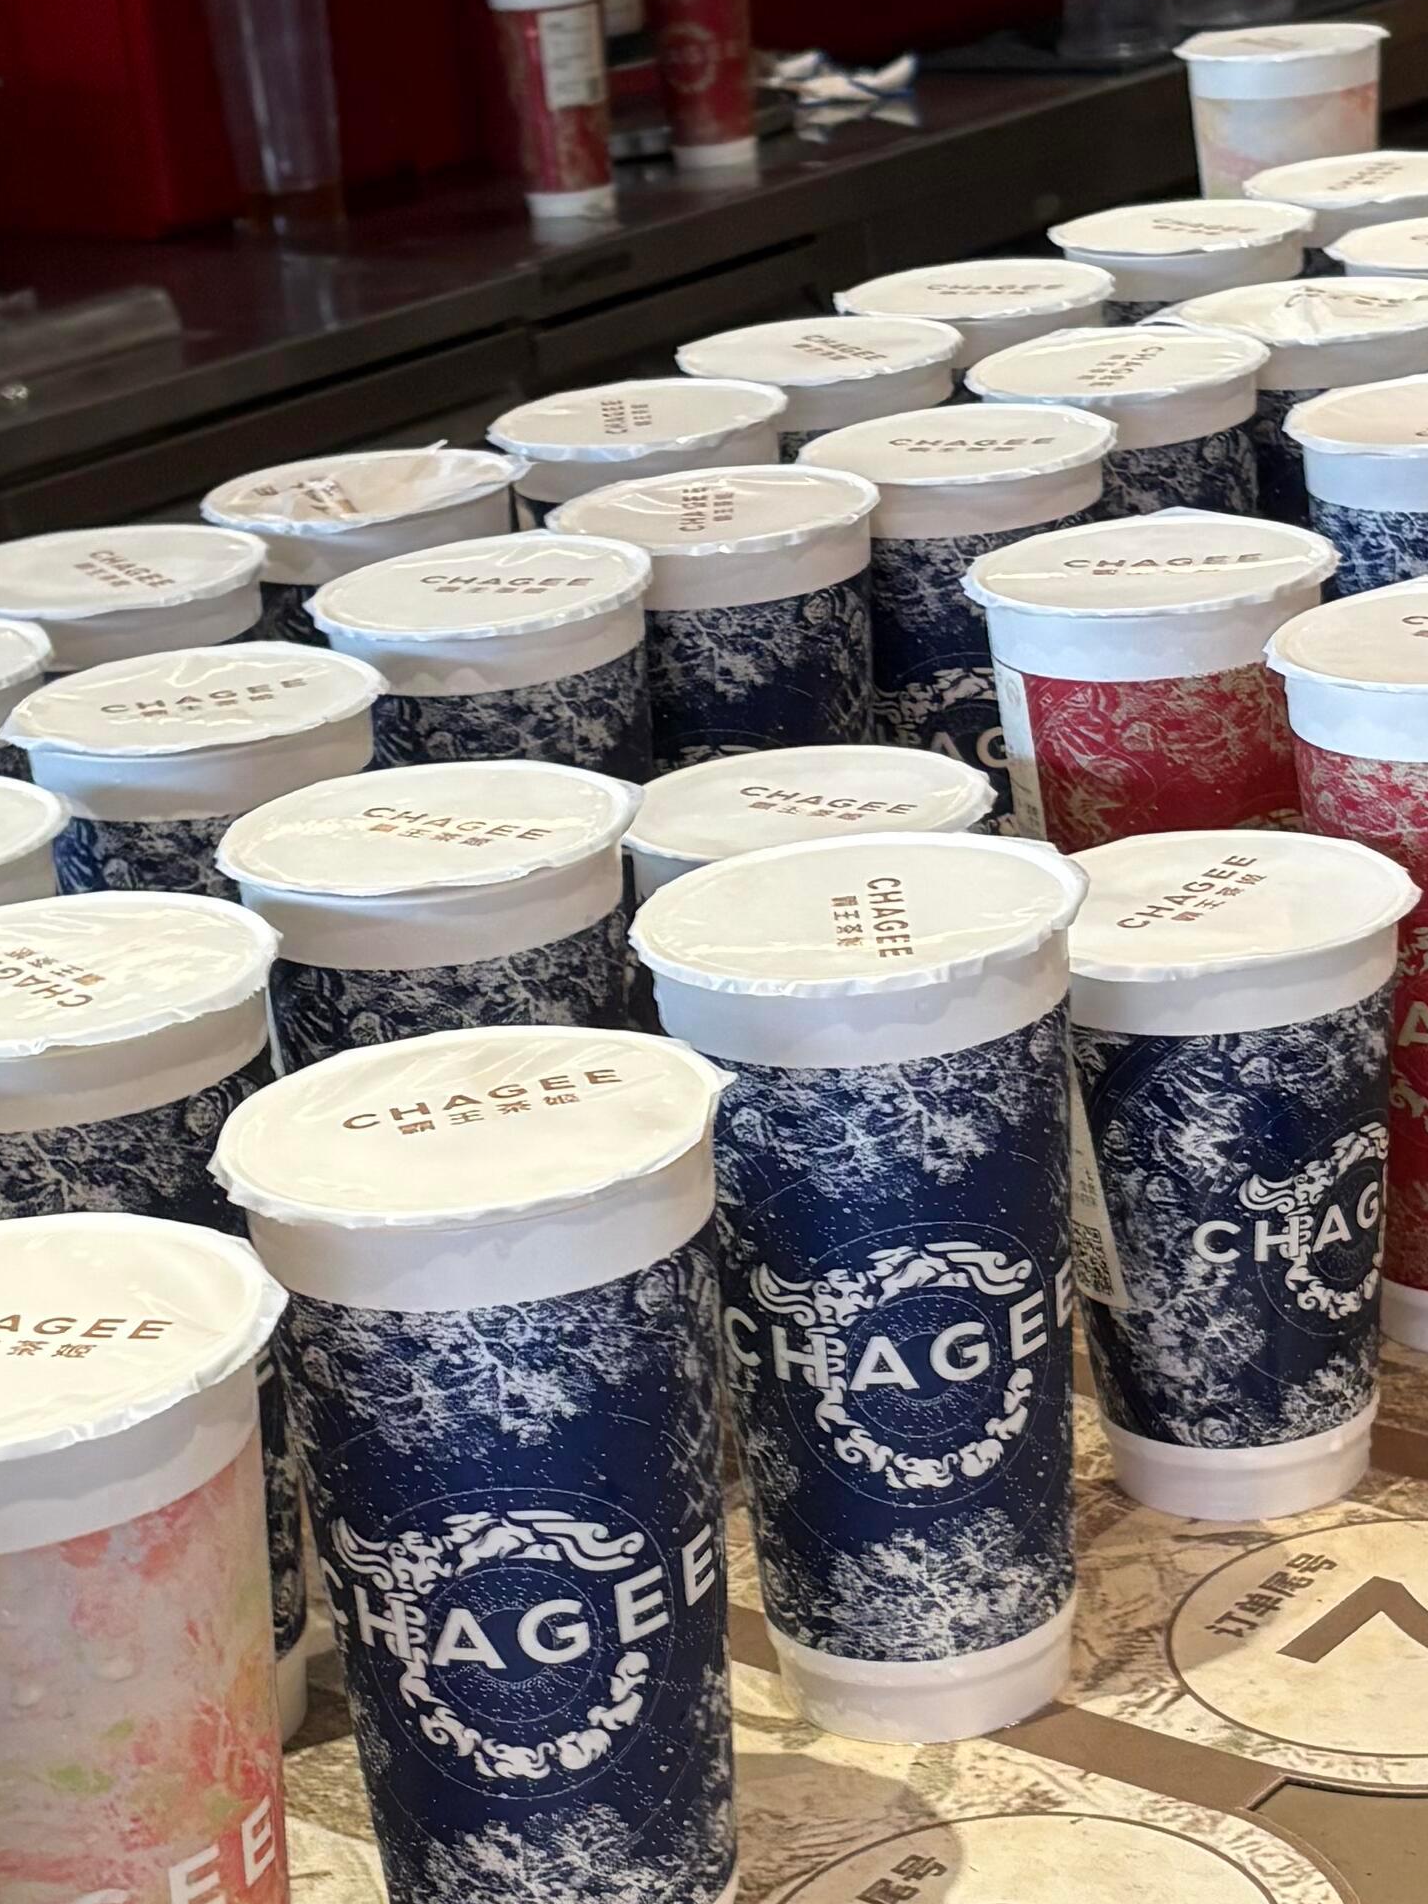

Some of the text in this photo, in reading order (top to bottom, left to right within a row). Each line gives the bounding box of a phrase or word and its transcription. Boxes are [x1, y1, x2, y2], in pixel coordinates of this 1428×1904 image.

[89, 550, 175, 587] CHAGEE
[420, 575, 594, 588] CHAGEE
[1064, 552, 1264, 569] CHAGEE
[101, 677, 309, 714] CHAGEE
[739, 784, 918, 815] CHAGEE
[363, 806, 553, 841] CHAGEE
[1117, 855, 1258, 930] CHAGEE
[867, 876, 914, 958] CHAGEE
[342, 1068, 623, 1131] CHAGEE
[398, 1092, 581, 1135] 霸王茶姬
[722, 1254, 1074, 1393] CHAGEE
[319, 1523, 717, 1669] CHAGEE
[1204, 1550, 1340, 1640] 订单尾号
